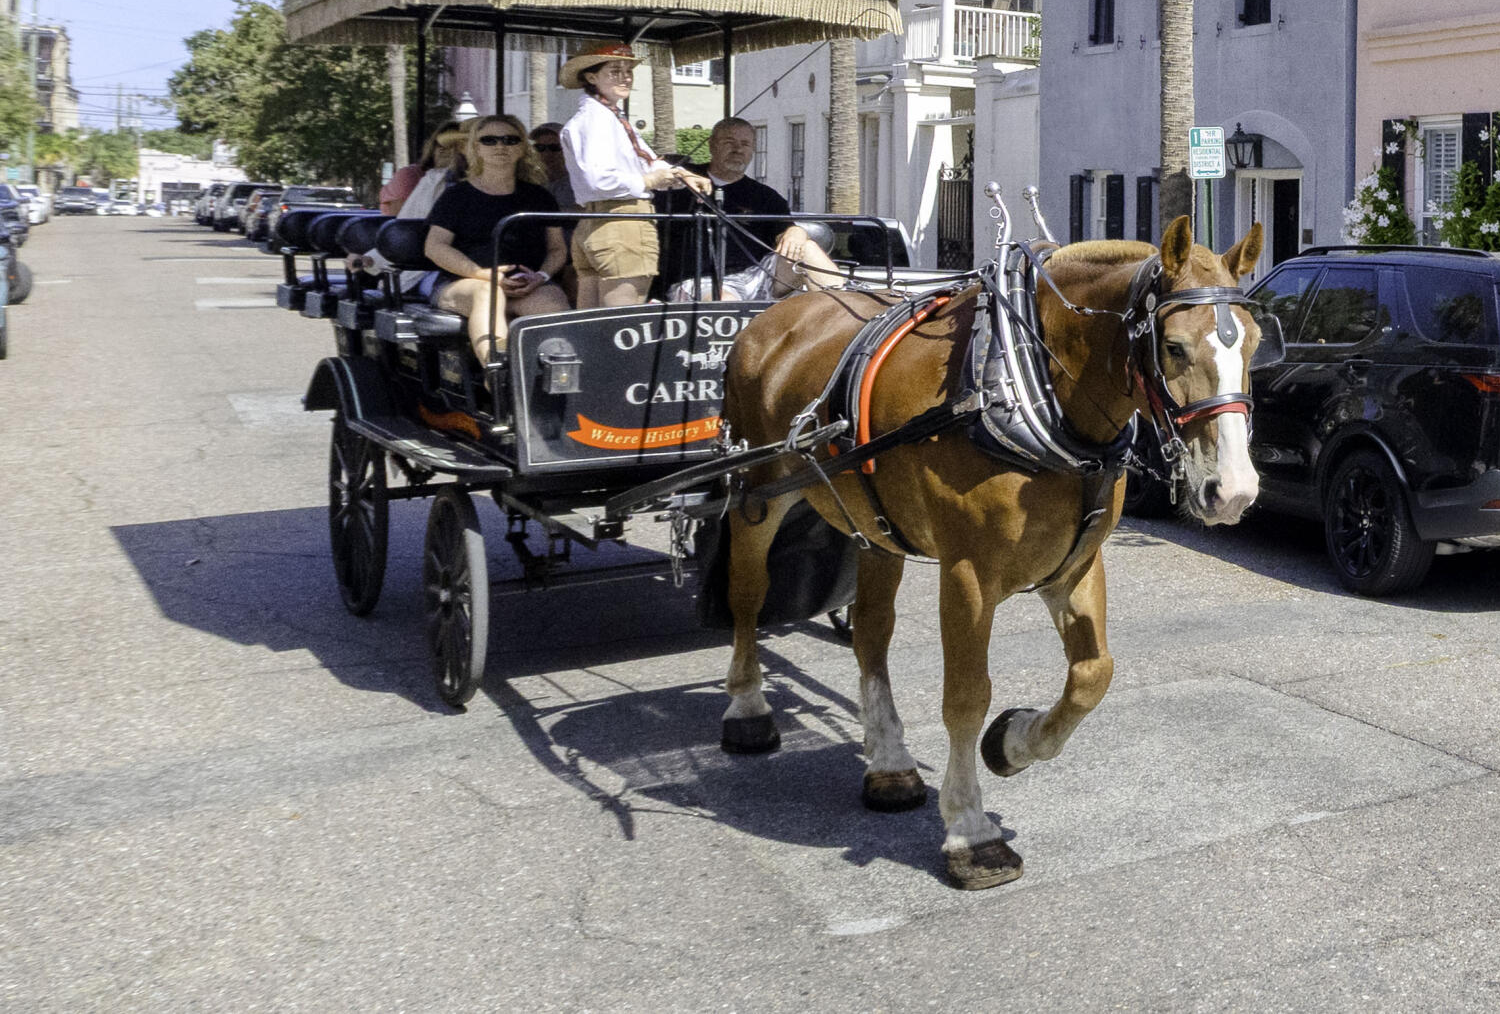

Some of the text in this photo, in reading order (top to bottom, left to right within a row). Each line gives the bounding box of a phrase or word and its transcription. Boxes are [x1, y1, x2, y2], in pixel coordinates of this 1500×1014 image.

[1193, 131, 1198, 145] 1
[613, 318, 688, 350] OLD
[625, 379, 725, 405] CARR
[591, 428, 639, 444] Where
[644, 425, 699, 444] History
